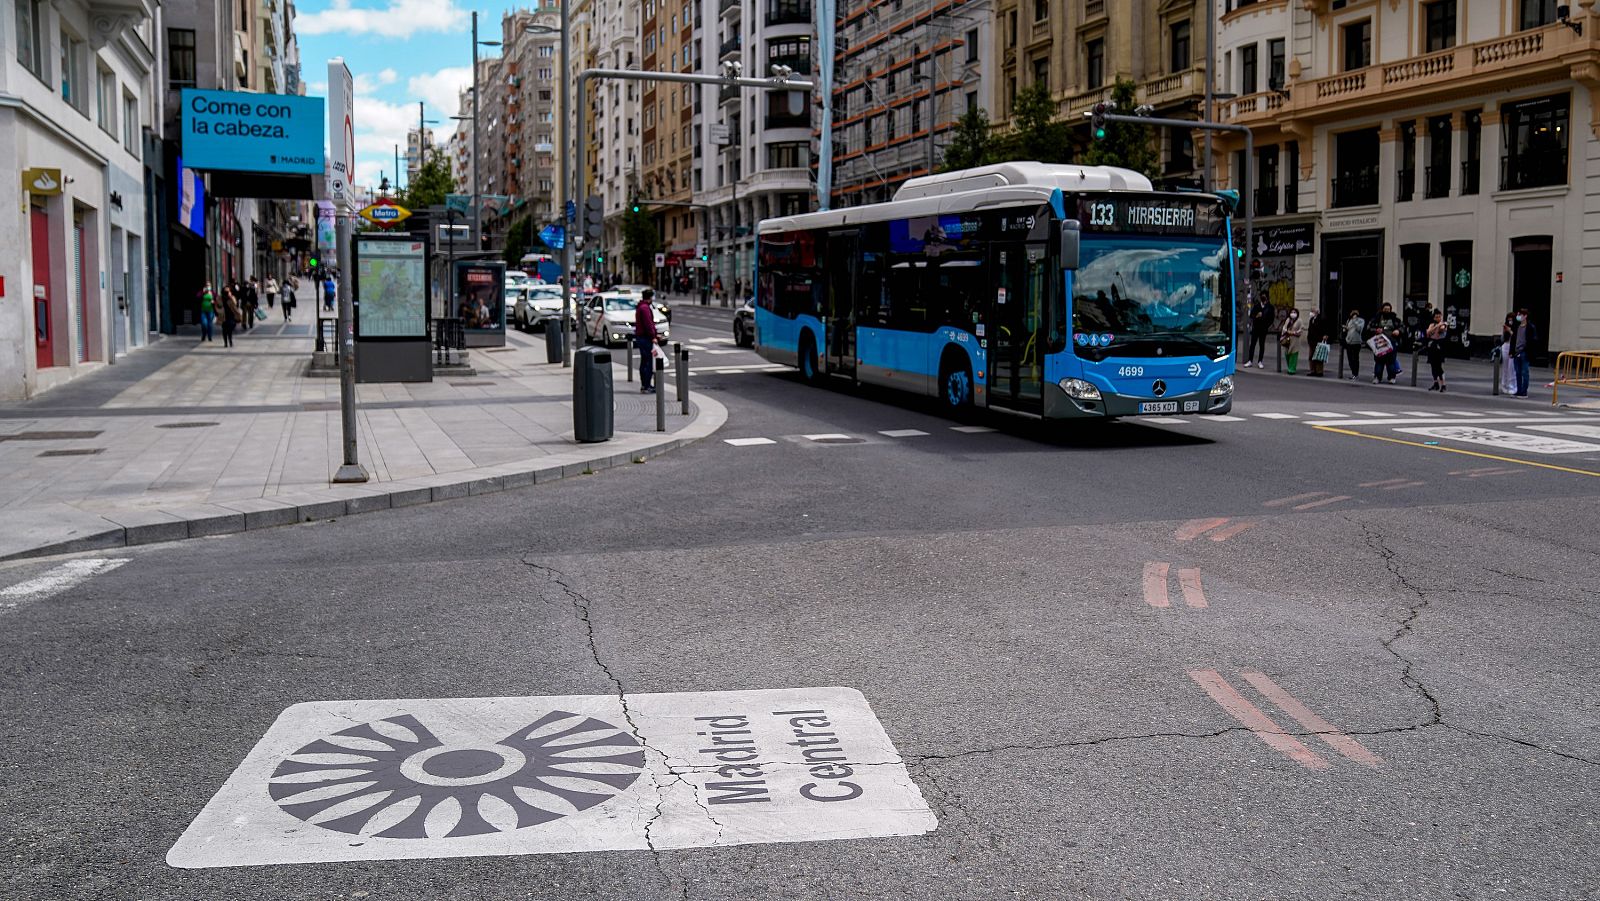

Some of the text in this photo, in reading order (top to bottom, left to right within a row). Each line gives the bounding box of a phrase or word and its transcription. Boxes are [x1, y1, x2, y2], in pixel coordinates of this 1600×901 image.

[192, 96, 291, 119] Come con
[192, 117, 289, 139] la cabeza.
[281, 157, 316, 165] MADRID
[374, 208, 397, 217] Metro
[1089, 203, 1195, 227] 133 MIRASIERRA
[1118, 366, 1144, 377] 4699
[1143, 402, 1176, 412] 4365 KDT
[1185, 402, 1198, 411] SP
[694, 714, 771, 805] Madrid
[772, 709, 864, 802] Central
